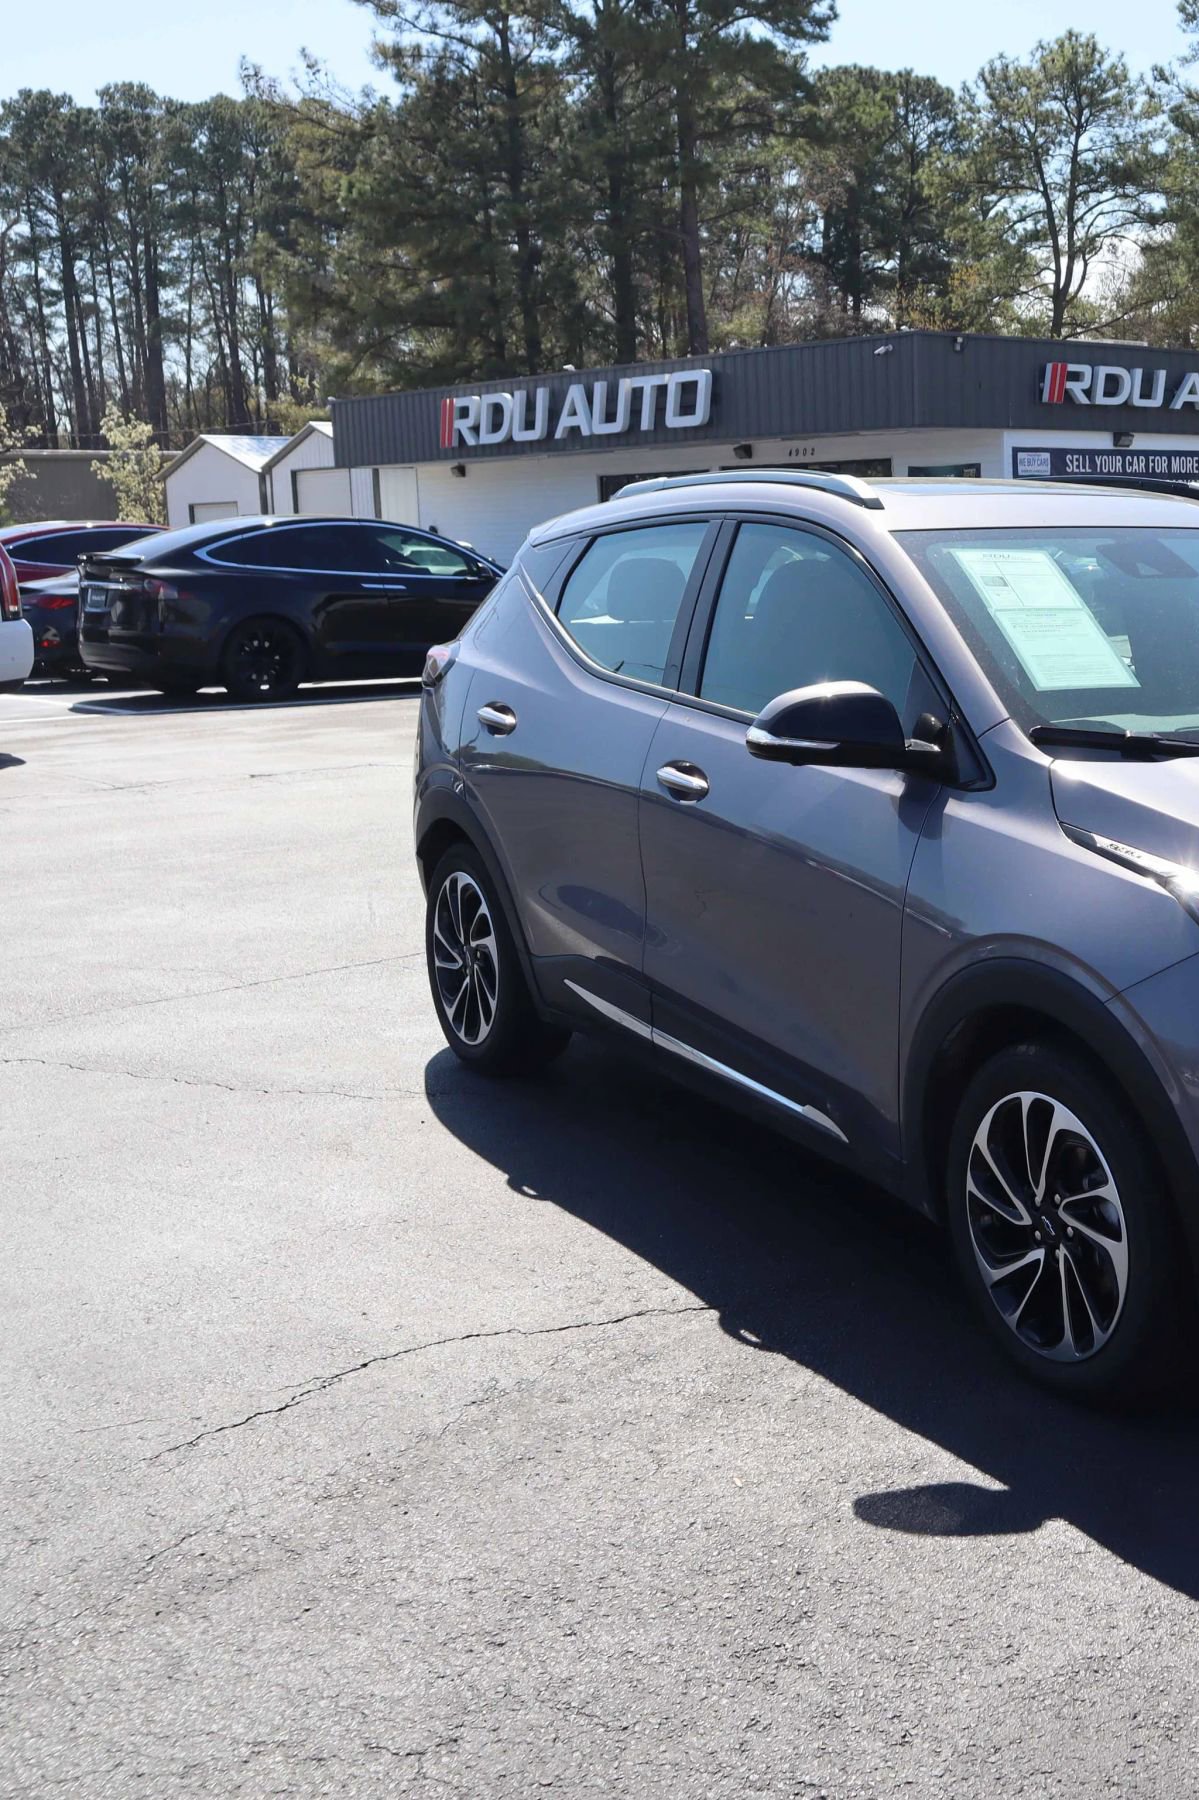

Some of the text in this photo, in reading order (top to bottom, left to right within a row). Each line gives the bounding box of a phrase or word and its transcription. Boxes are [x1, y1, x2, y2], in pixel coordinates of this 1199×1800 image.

[451, 368, 713, 447] RDU AUTO
[1062, 363, 1167, 408] RDU
[1065, 454, 1092, 473] SELL
[1094, 455, 1123, 473] YOUR
[1125, 455, 1146, 473] CAR
[1148, 455, 1168, 474] FOR
